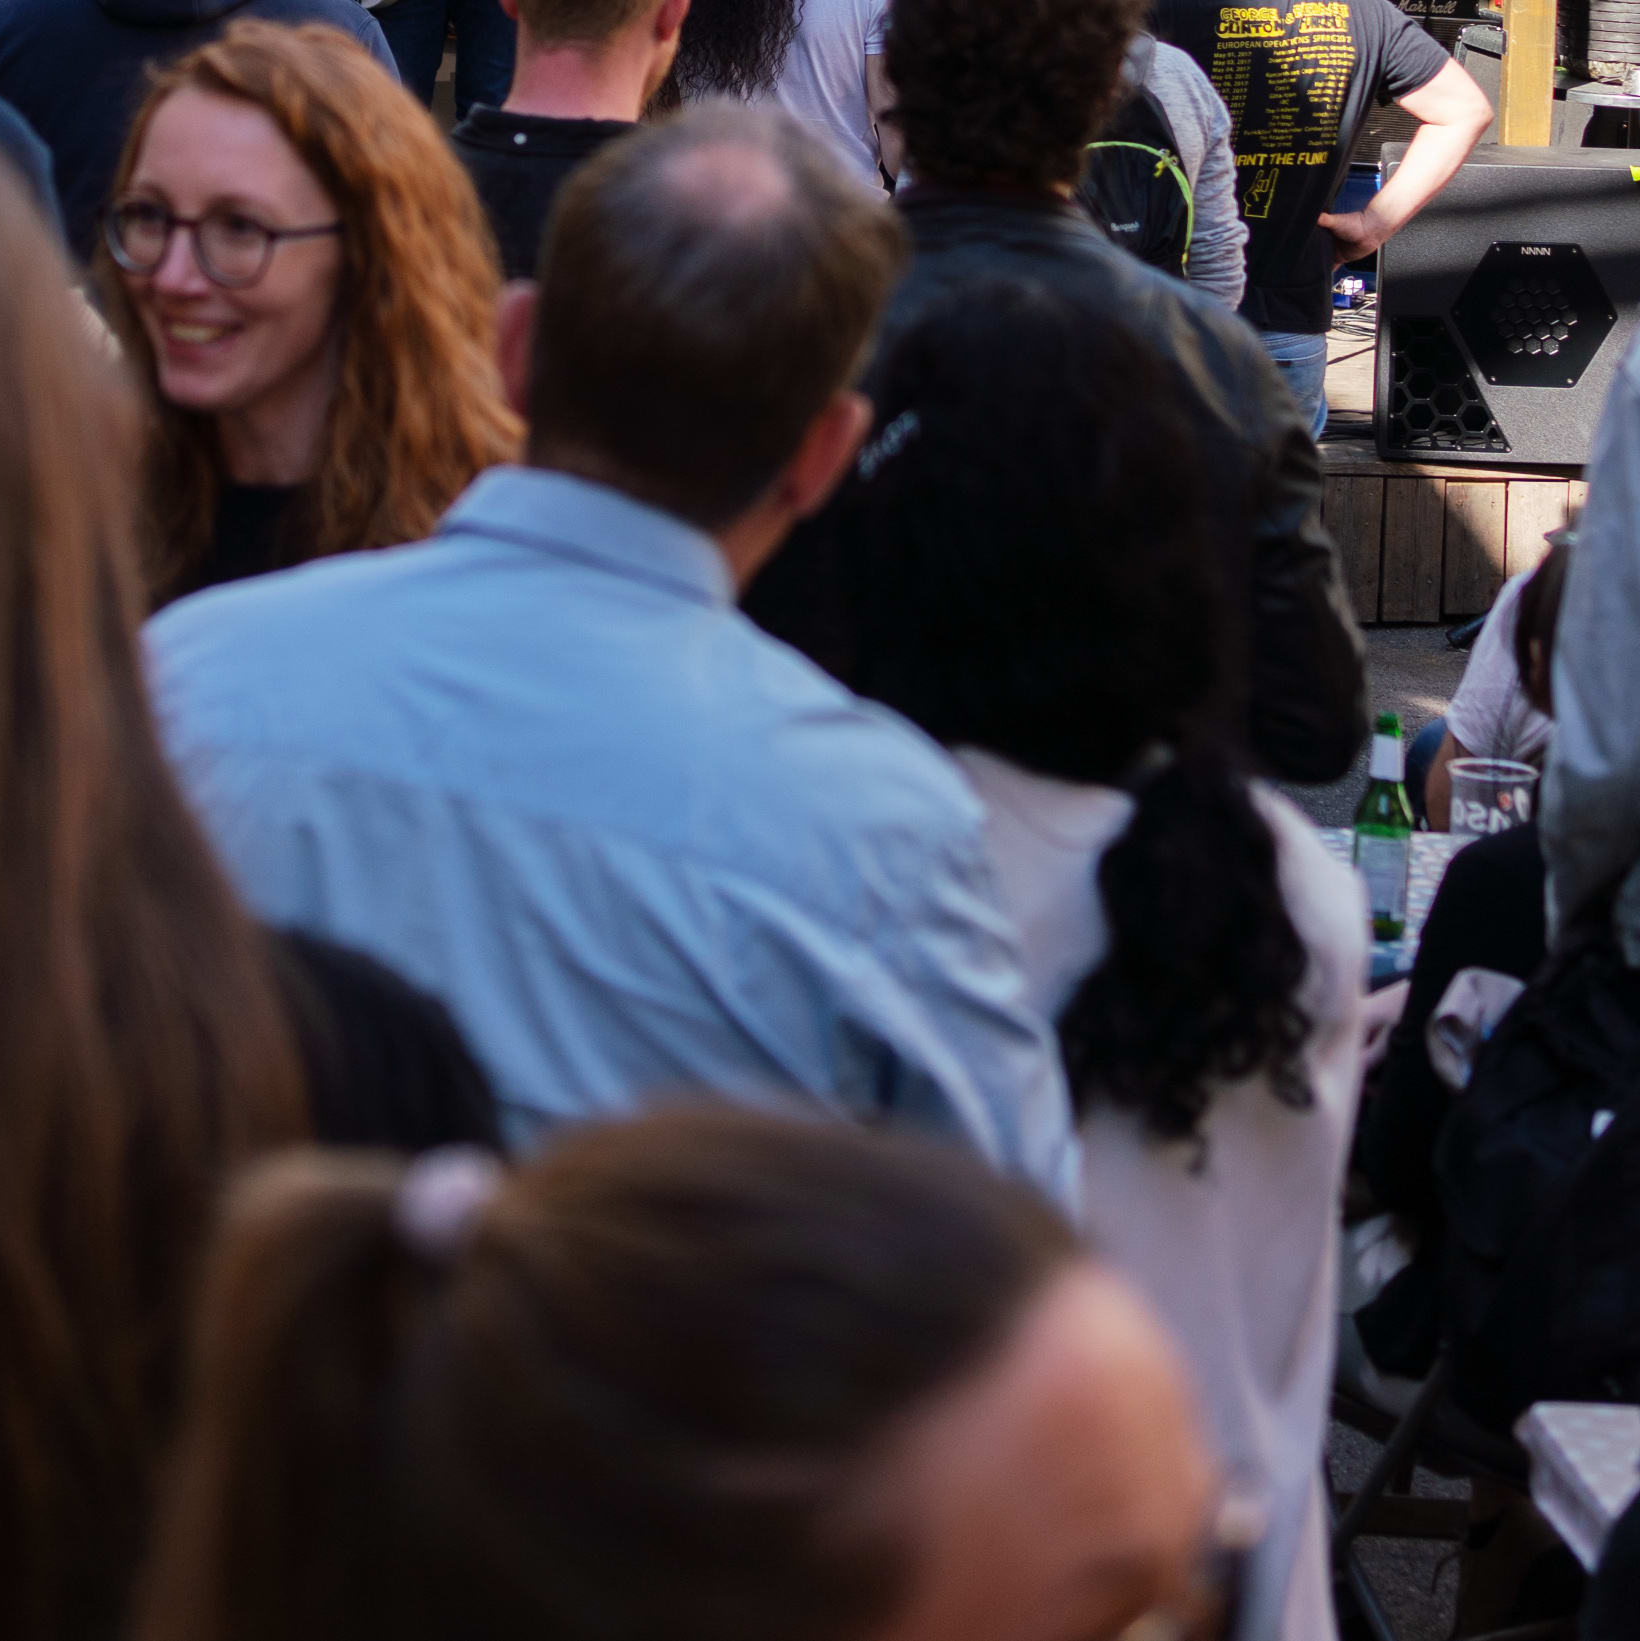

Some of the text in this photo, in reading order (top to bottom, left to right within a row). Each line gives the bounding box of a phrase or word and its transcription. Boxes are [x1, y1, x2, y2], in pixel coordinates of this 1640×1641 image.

[1220, 7, 1278, 21] GEORGE
[1215, 19, 1284, 38] CLINTON
[1217, 40, 1261, 50] EUROPEAN
[1234, 153, 1267, 166] ANT
[1270, 152, 1296, 165] THE
